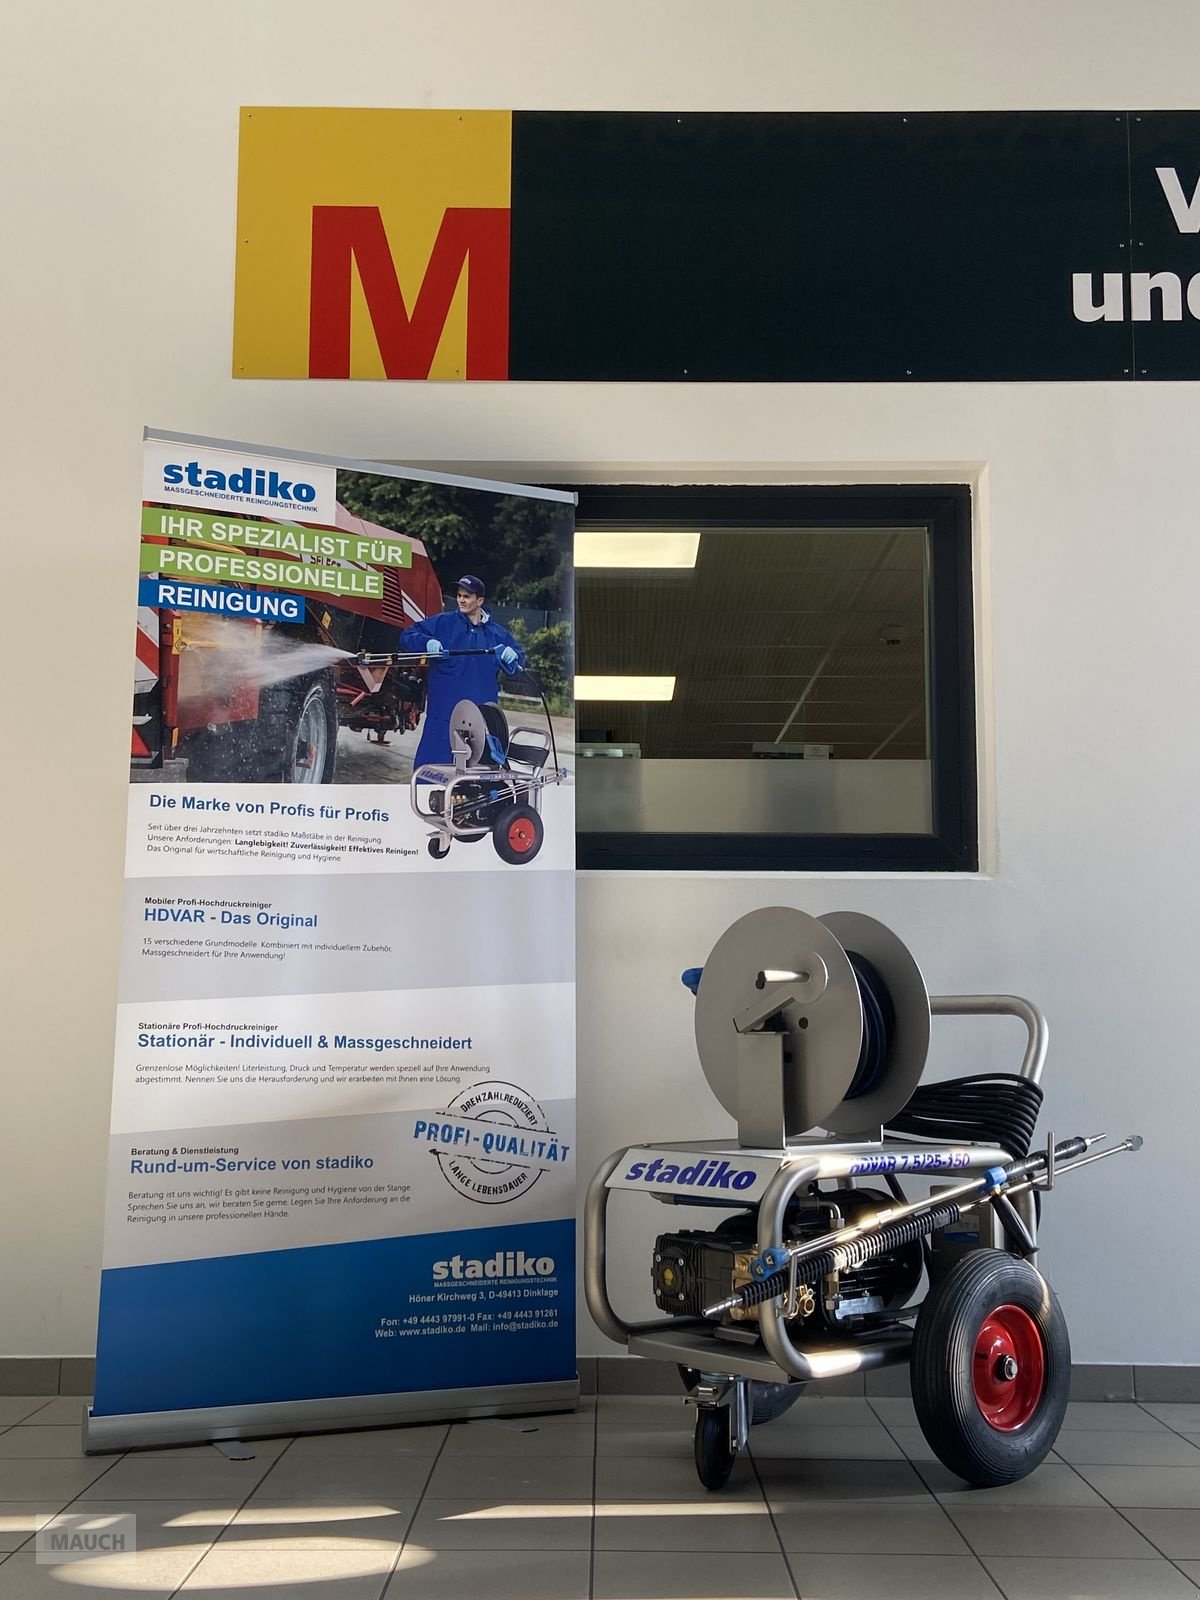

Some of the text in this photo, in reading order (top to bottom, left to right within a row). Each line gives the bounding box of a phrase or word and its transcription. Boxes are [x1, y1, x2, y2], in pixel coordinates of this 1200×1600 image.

[308, 205, 511, 380] M
[163, 461, 316, 503] stadiko
[164, 485, 318, 513] MASSGESCHNEIDERTE REINIGUNGSTECHNIK
[160, 515, 204, 538] IHR
[211, 521, 350, 556] SPEZIALIST
[356, 539, 403, 565] FÜR
[159, 549, 380, 594] PROFESSIONELLE
[158, 584, 299, 618] REINIGUNG
[150, 794, 390, 822] Die Marke von Profis für Profis
[147, 823, 162, 831] Seit
[164, 824, 181, 833] über
[183, 825, 198, 833] drei
[199, 826, 243, 836] Jahrzehnten
[245, 829, 262, 837] setzt
[264, 830, 289, 838] stadiko
[291, 831, 325, 841] Maßstäbe
[147, 834, 174, 842] Unsere
[235, 839, 289, 850] Langlebigkeit!
[290, 841, 347, 853] Zuverlässigkeit!
[349, 845, 384, 855] Effektives
[385, 847, 419, 857] Reinigen!
[147, 844, 161, 852] Das
[163, 845, 193, 855] Original
[195, 846, 205, 854] für
[207, 847, 259, 858] wirtschaftliche
[260, 851, 296, 860] Reinigung
[144, 897, 272, 910] Mobiler Profi-Hochdruckreiniger
[144, 908, 205, 923] HDVAR
[221, 910, 252, 925] Das
[256, 912, 318, 930] Original
[154, 938, 203, 947] verschiedene
[260, 941, 300, 949] Kombiniert
[142, 948, 210, 959] Massgeschneidert
[212, 950, 222, 958] für
[240, 951, 286, 961] Anwendung!
[138, 1022, 278, 1032] Stationäre Profi-Hochdruckreiniger
[138, 1033, 215, 1048] Stationär
[230, 1034, 312, 1048] Individuell
[317, 1035, 329, 1049] &
[334, 1035, 472, 1052] Massgeschneidert
[135, 1064, 183, 1072] Grenzenlose
[185, 1064, 240, 1073] Möglichkeiten!
[289, 1064, 310, 1072] Druck
[312, 1064, 326, 1072] und
[328, 1064, 368, 1073] Temperatur
[396, 1064, 422, 1074] speziell
[450, 1065, 491, 1074] Anwendung
[185, 1075, 215, 1083] Nennen
[217, 1075, 228, 1083] Sie
[245, 1075, 257, 1083] die
[258, 1075, 319, 1085] Herausforderung
[320, 1075, 335, 1083] und
[348, 1075, 385, 1083] erarbeiten
[385, 1075, 397, 1083] mit
[460, 1091, 539, 1126] DREHZAHLREDUZIERT
[131, 1146, 239, 1157] Beratung & Dienstleistung
[130, 1155, 374, 1174] Rund-um-Service von stadiko
[449, 1160, 528, 1195] LANGE LEBENSDAUER
[624, 1158, 757, 1191] stadiko
[128, 1191, 164, 1200] Beratung
[166, 1191, 175, 1199] ist
[193, 1189, 223, 1199] wichtig!
[234, 1188, 250, 1198] gibt
[251, 1188, 272, 1196] keine
[273, 1186, 310, 1197] Reinigung
[311, 1186, 326, 1194] und
[327, 1185, 357, 1195] Hygiene
[127, 1202, 164, 1212] Sprechen
[166, 1202, 177, 1210] Sie
[208, 1201, 221, 1209] wir
[222, 1200, 251, 1208] beraten
[253, 1199, 264, 1207] Sie
[290, 1198, 313, 1207] Legen
[314, 1197, 326, 1205] Sie
[343, 1195, 388, 1205] Anforderung
[127, 1214, 166, 1224] Reinigung
[178, 1213, 204, 1221] unsere
[205, 1211, 262, 1221] professionellen
[432, 1251, 555, 1280] stadiko
[433, 1277, 558, 1288] MASSGESCHNEIDERTE REINIGUNGSTECHNIK
[409, 1287, 558, 1303] Höner Kirchweg 3, D-49413 Dinklage
[380, 1318, 400, 1326] Fon:
[402, 1316, 418, 1325] +49
[420, 1314, 440, 1324] 4443
[442, 1313, 475, 1323] 97991-0
[477, 1312, 495, 1321] Fax:
[497, 1311, 512, 1319] +49
[514, 1310, 533, 1318] 4443
[375, 1320, 559, 1338] Web: www.stadiko.de Mail: info@stadiko.de
